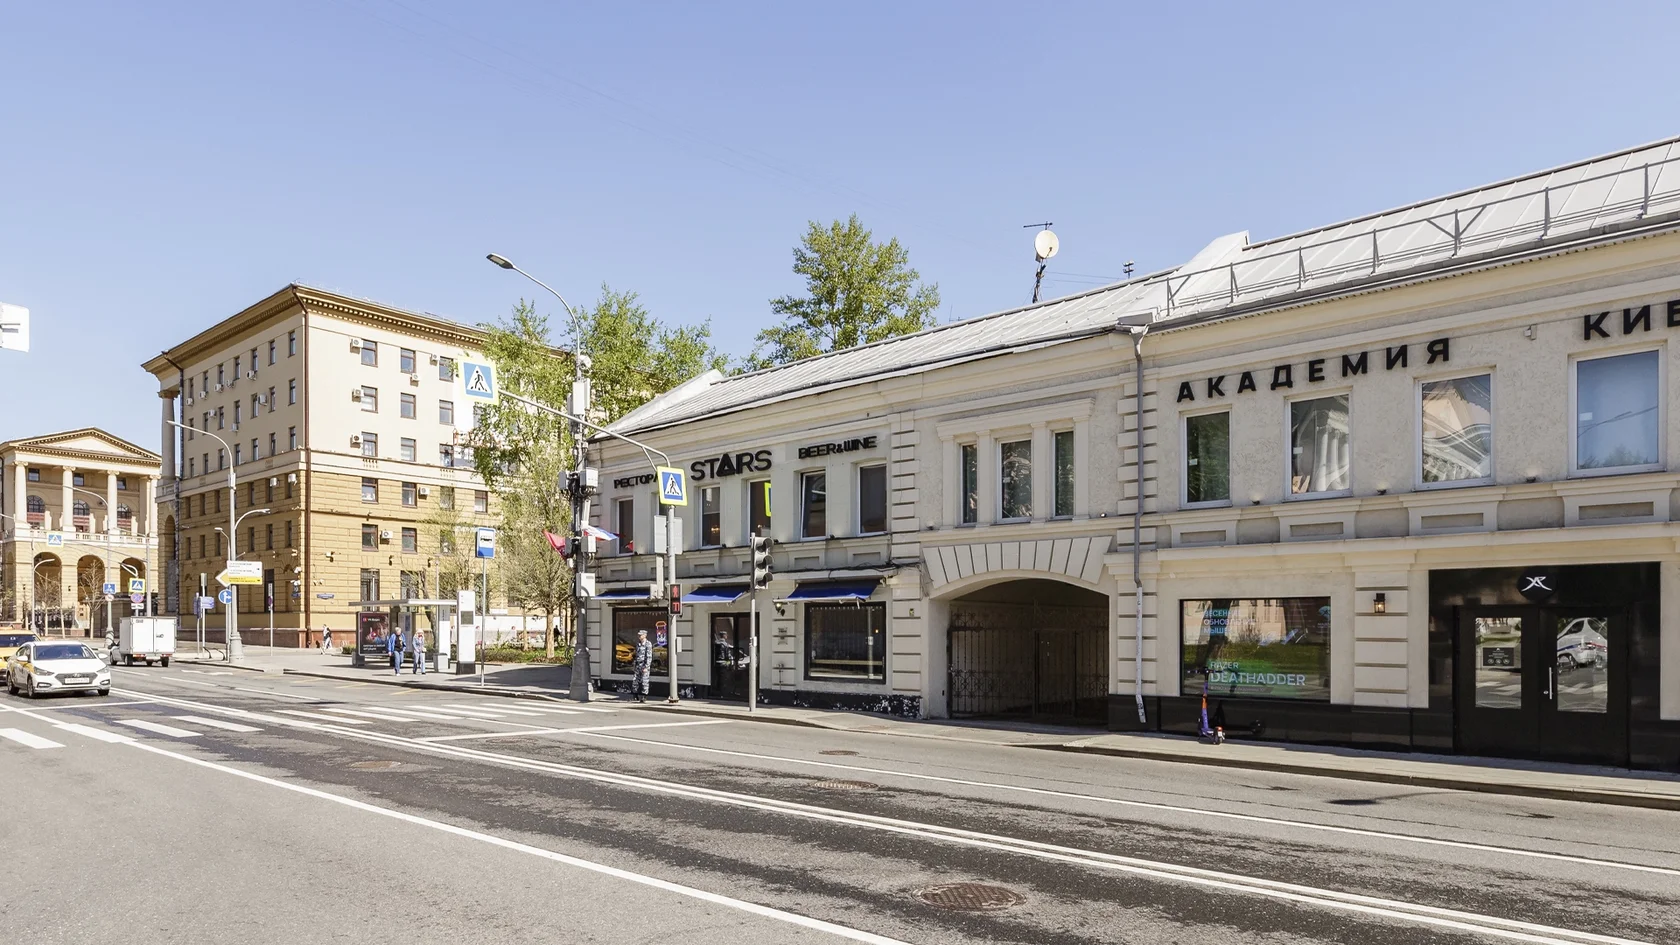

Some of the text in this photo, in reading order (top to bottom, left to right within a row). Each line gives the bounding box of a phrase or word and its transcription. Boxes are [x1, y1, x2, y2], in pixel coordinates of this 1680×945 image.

[1176, 337, 1450, 403] АКАДЕМИЯ
[690, 450, 773, 481] STARS
[1210, 661, 1239, 669] RAZER
[1210, 672, 1306, 686] DEATHADDER
